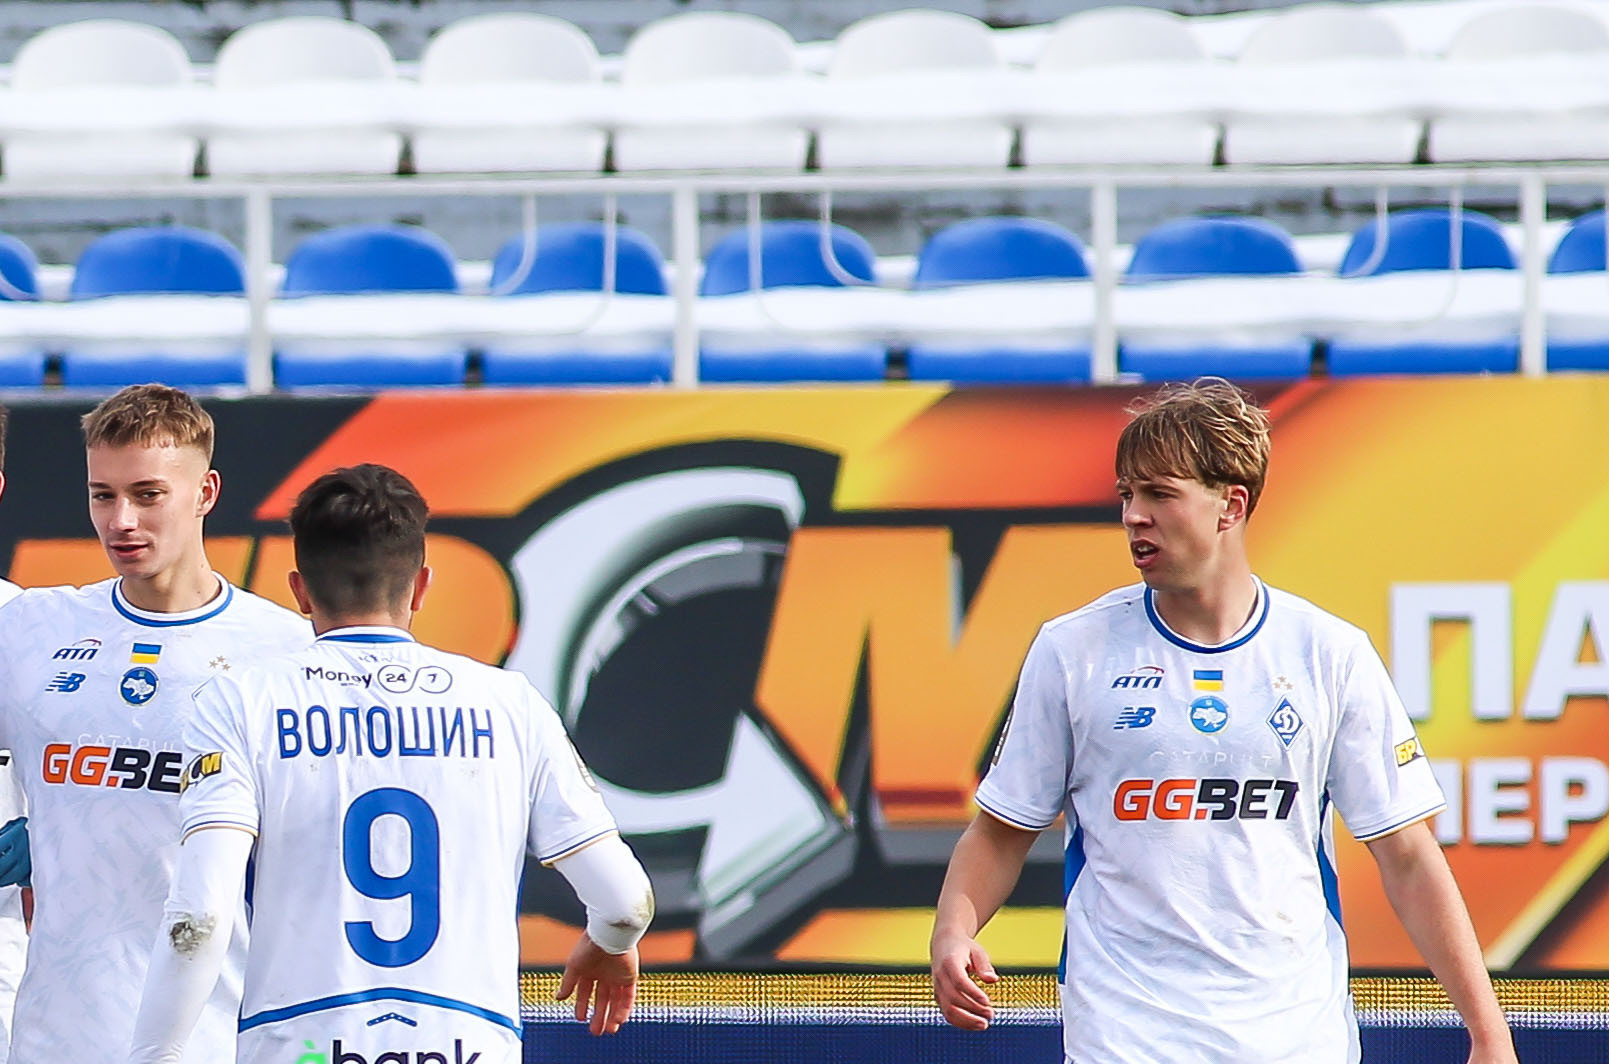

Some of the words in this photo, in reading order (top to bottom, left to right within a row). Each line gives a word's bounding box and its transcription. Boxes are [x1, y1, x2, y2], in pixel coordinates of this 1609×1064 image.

[385, 673, 407, 683] 24
[277, 704, 495, 759] ВОЛОШИН
[42, 743, 181, 794] GG.BE
[1113, 779, 1300, 821] GG.BET
[343, 786, 440, 968] 9
